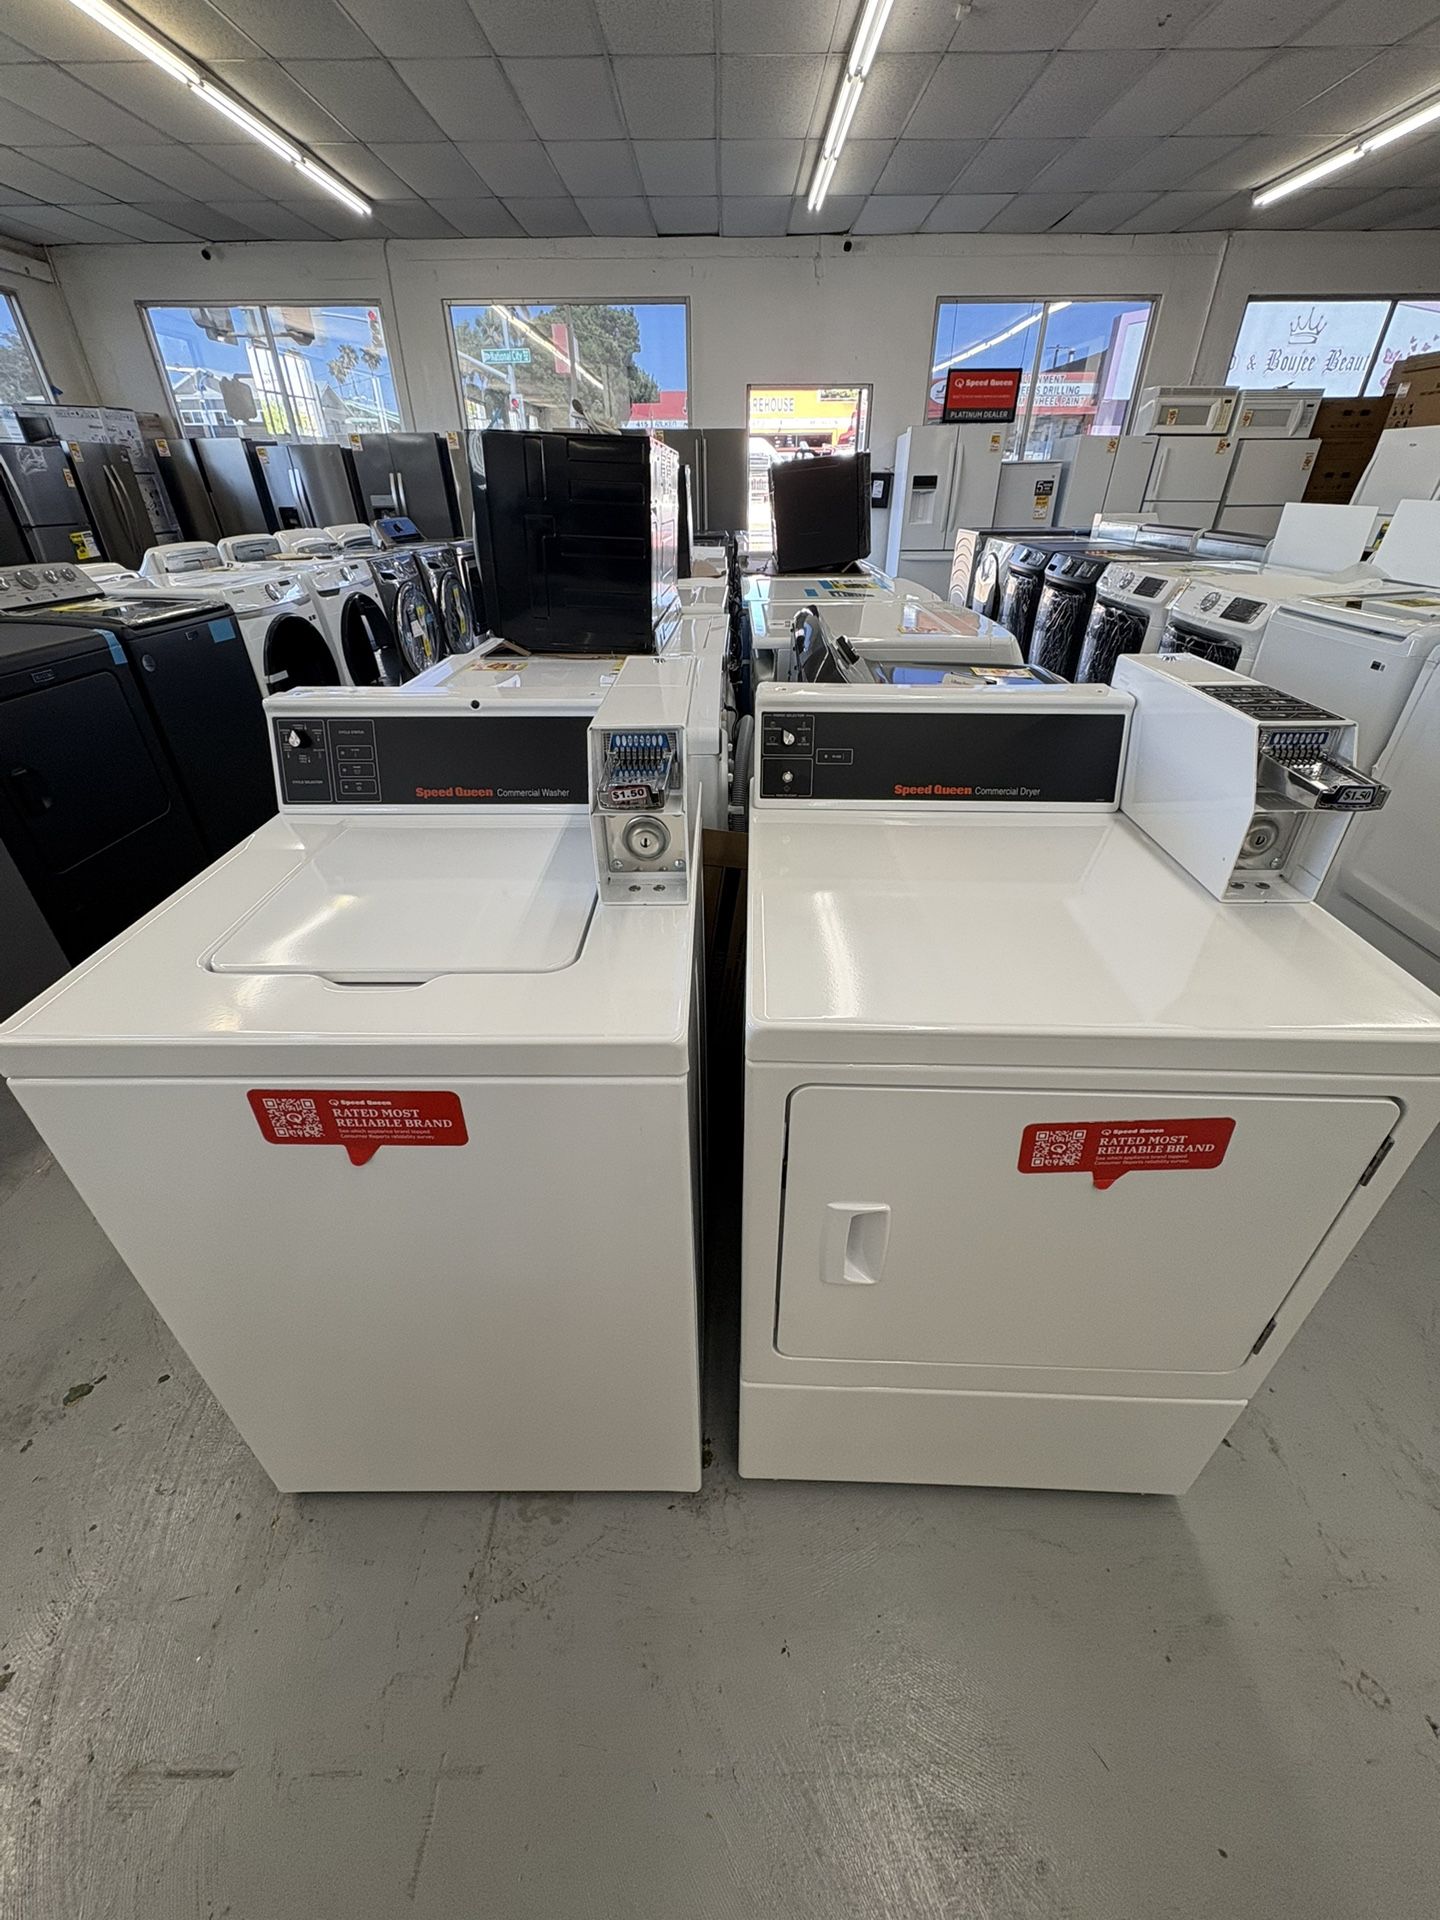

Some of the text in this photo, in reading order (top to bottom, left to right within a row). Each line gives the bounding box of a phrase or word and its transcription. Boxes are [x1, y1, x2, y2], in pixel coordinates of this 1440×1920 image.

[1246, 354, 1257, 371] &
[1264, 349, 1316, 375] Boujee
[965, 378, 1013, 387] Speed Queen
[1043, 385, 1080, 395] DRILLING
[752, 397, 794, 412] REHOUSE
[951, 410, 1008, 419] PLATINUM DEALER
[415, 786, 570, 799] Speed Queen Commercial Washer
[612, 788, 644, 800] $1.50
[894, 784, 1041, 797] Speed Queen Commercial Dryer
[1342, 790, 1371, 800] $1.50
[332, 1108, 420, 1118] RATED MOST
[335, 1118, 453, 1128] RELIABLE BRAND
[1099, 1135, 1188, 1146] RATED MOST
[1097, 1143, 1215, 1155] RELIABLE BRAND
